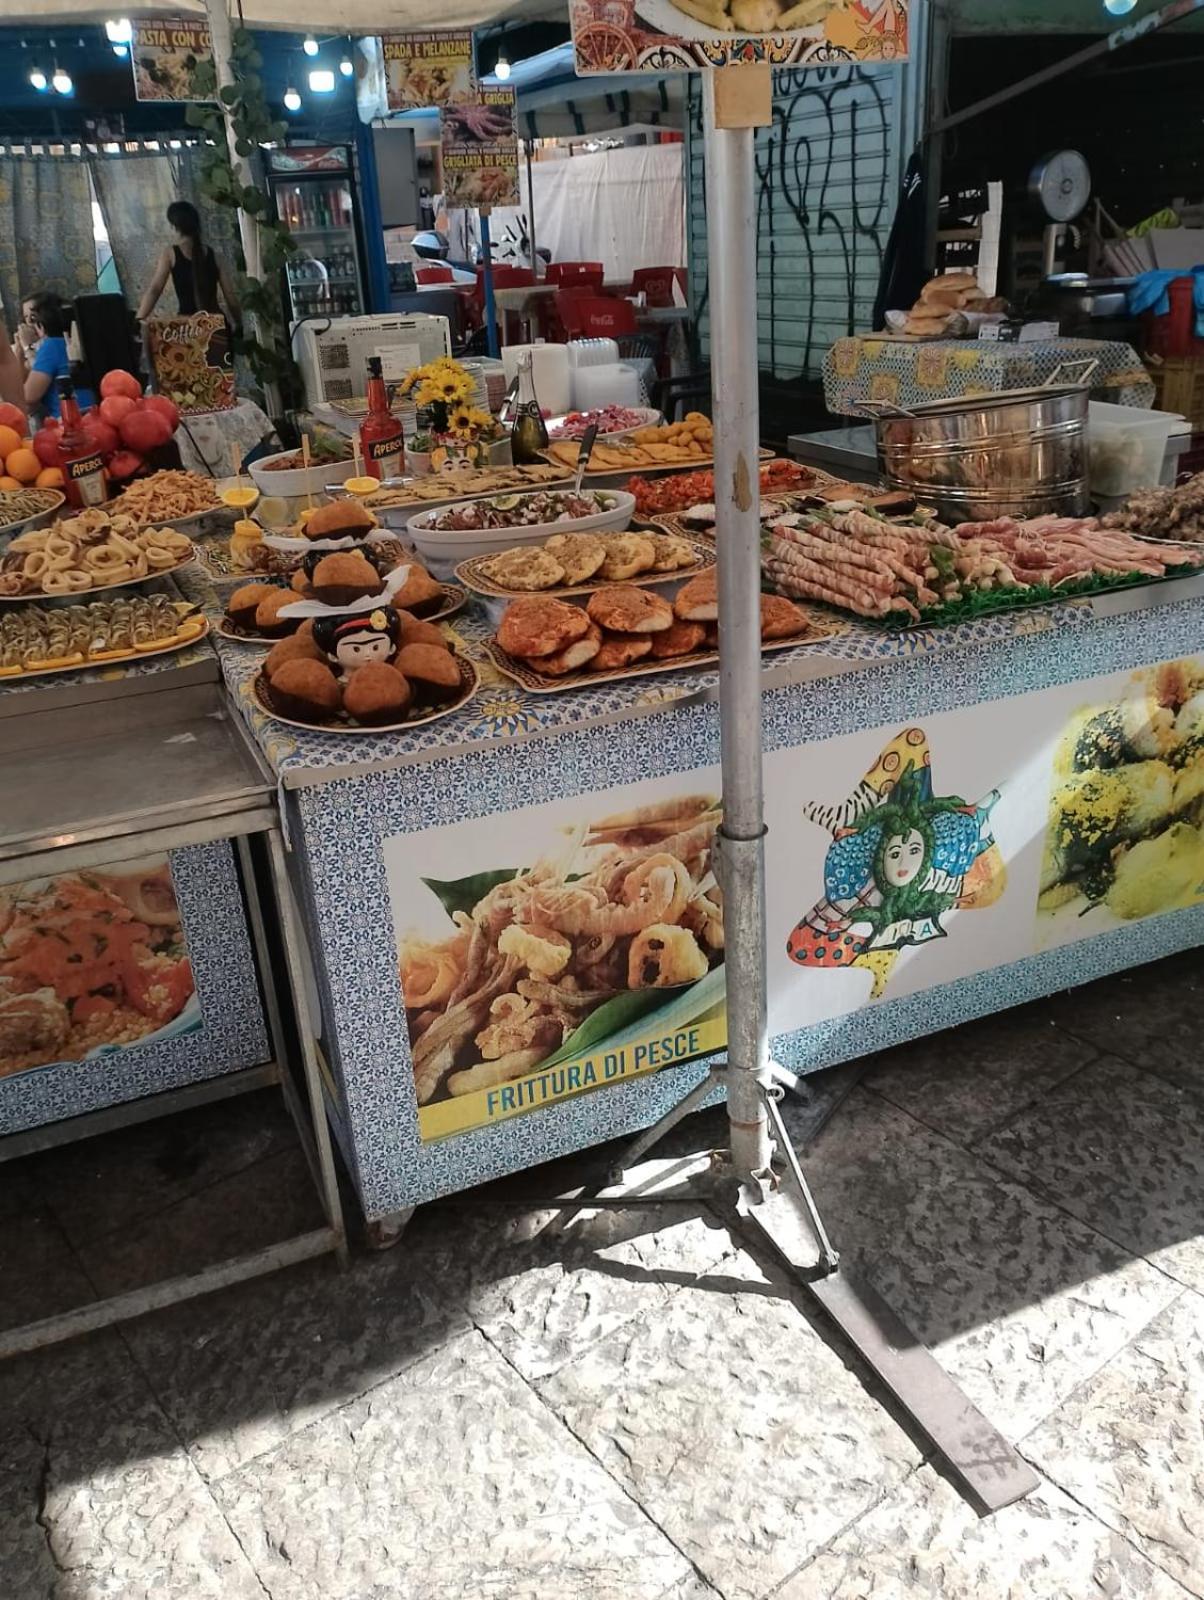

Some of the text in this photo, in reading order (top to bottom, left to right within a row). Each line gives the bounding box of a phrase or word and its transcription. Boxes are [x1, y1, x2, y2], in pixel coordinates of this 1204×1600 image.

[384, 40, 471, 59] SPADA E MELANZANE
[443, 154, 517, 169] GRIGLIATA DI PESCE
[487, 1029, 700, 1116] FRITTURA DI PESCE
